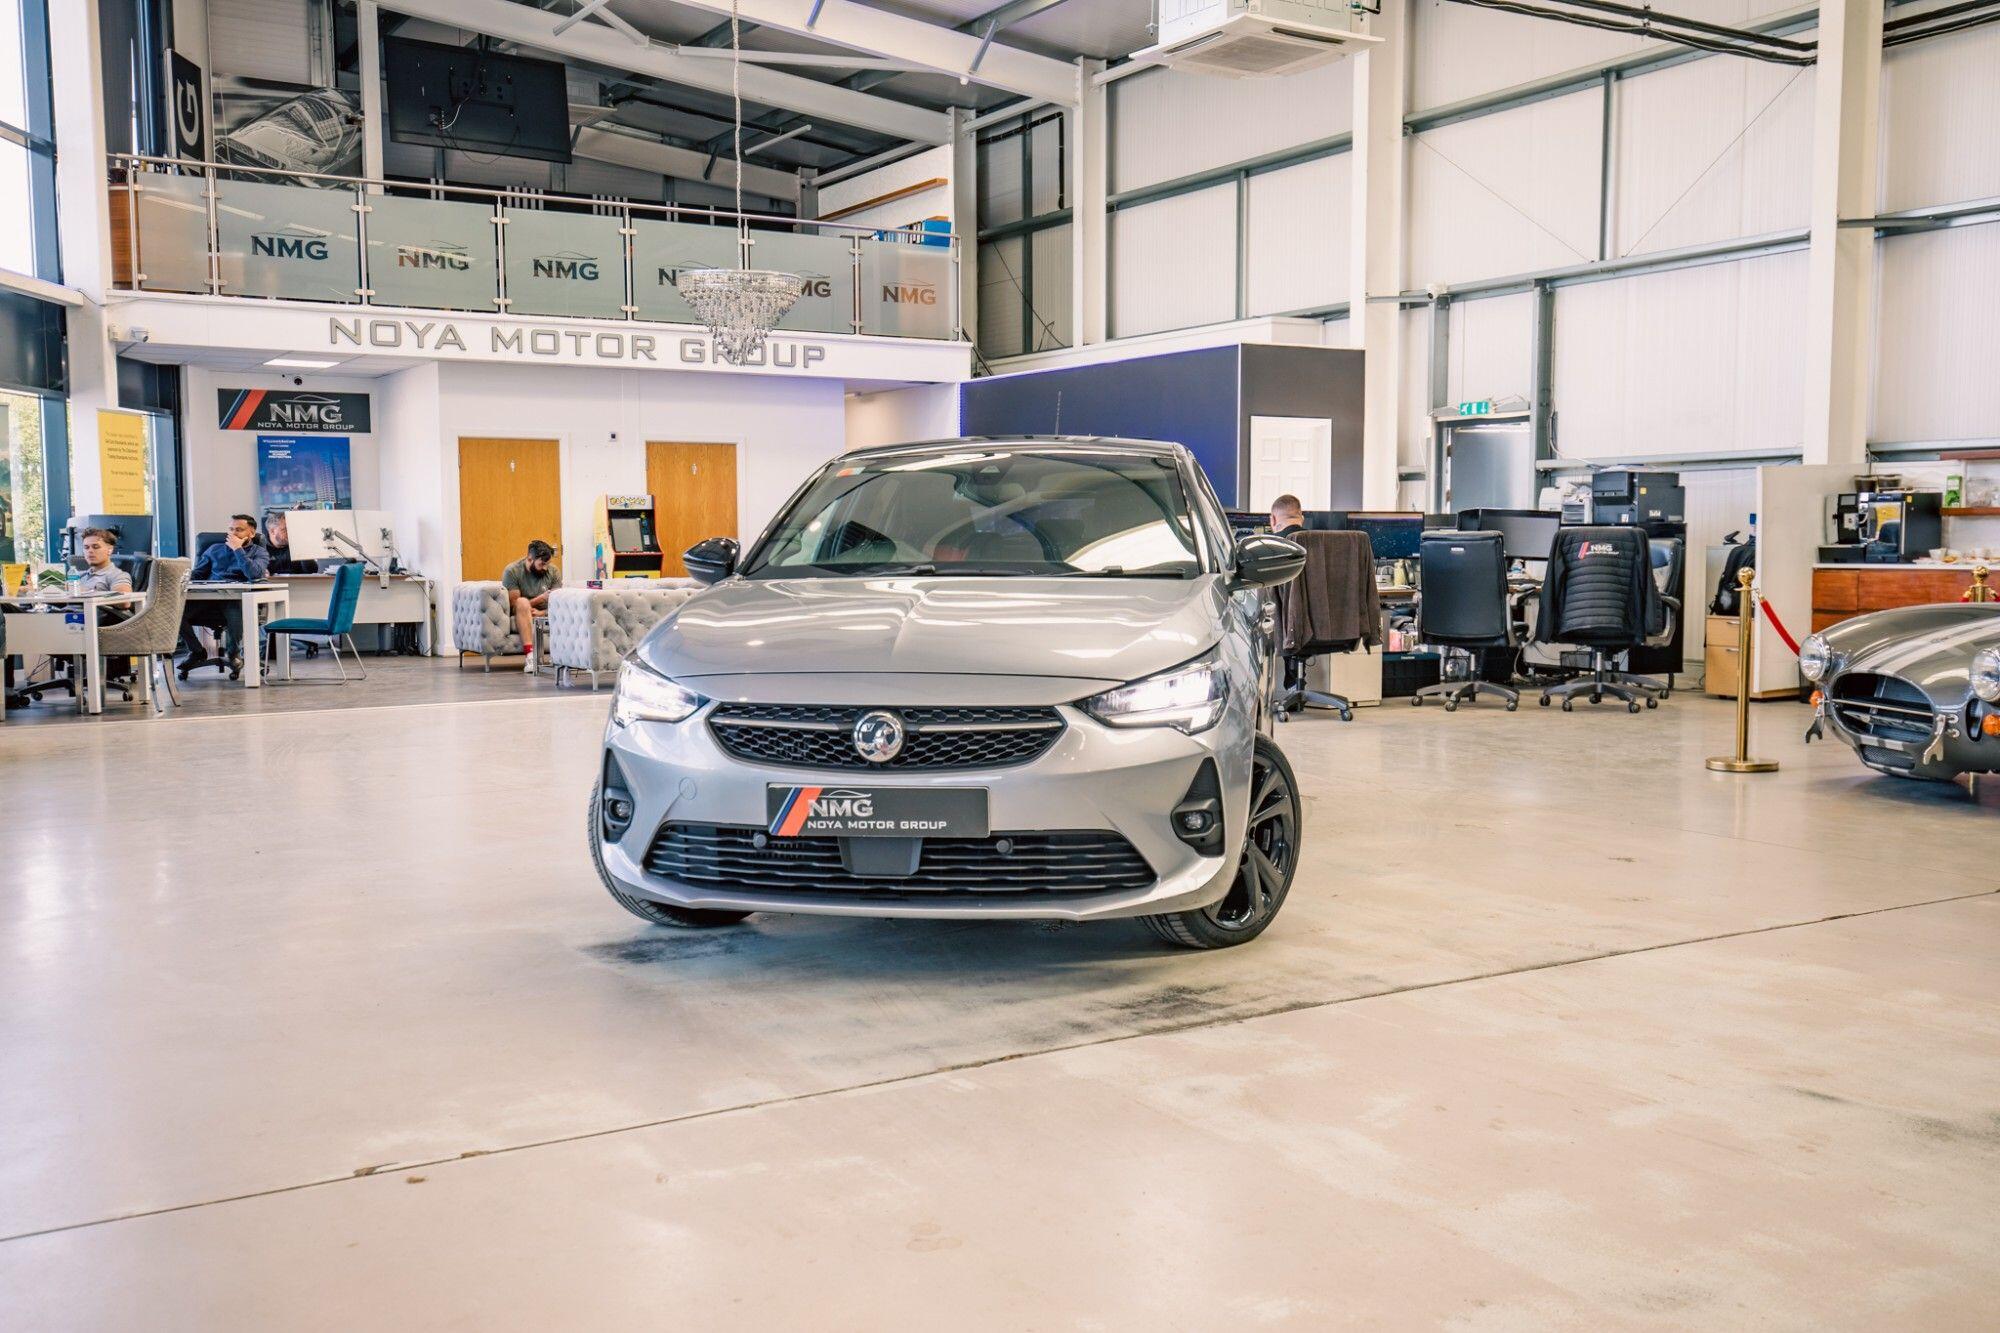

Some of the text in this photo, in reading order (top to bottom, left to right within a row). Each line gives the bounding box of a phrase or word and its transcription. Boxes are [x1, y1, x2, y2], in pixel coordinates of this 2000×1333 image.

[251, 236, 328, 260] NMG
[398, 248, 470, 271] NMG
[533, 259, 599, 281] NMG
[883, 285, 937, 305] NMG
[330, 317, 467, 351] NOYA
[491, 326, 657, 361] MOTOR
[269, 403, 343, 423] NMG
[1590, 544, 1613, 552] NMG
[808, 799, 874, 817] NMG
[807, 820, 947, 830] NOYA MOTOR GROUP
